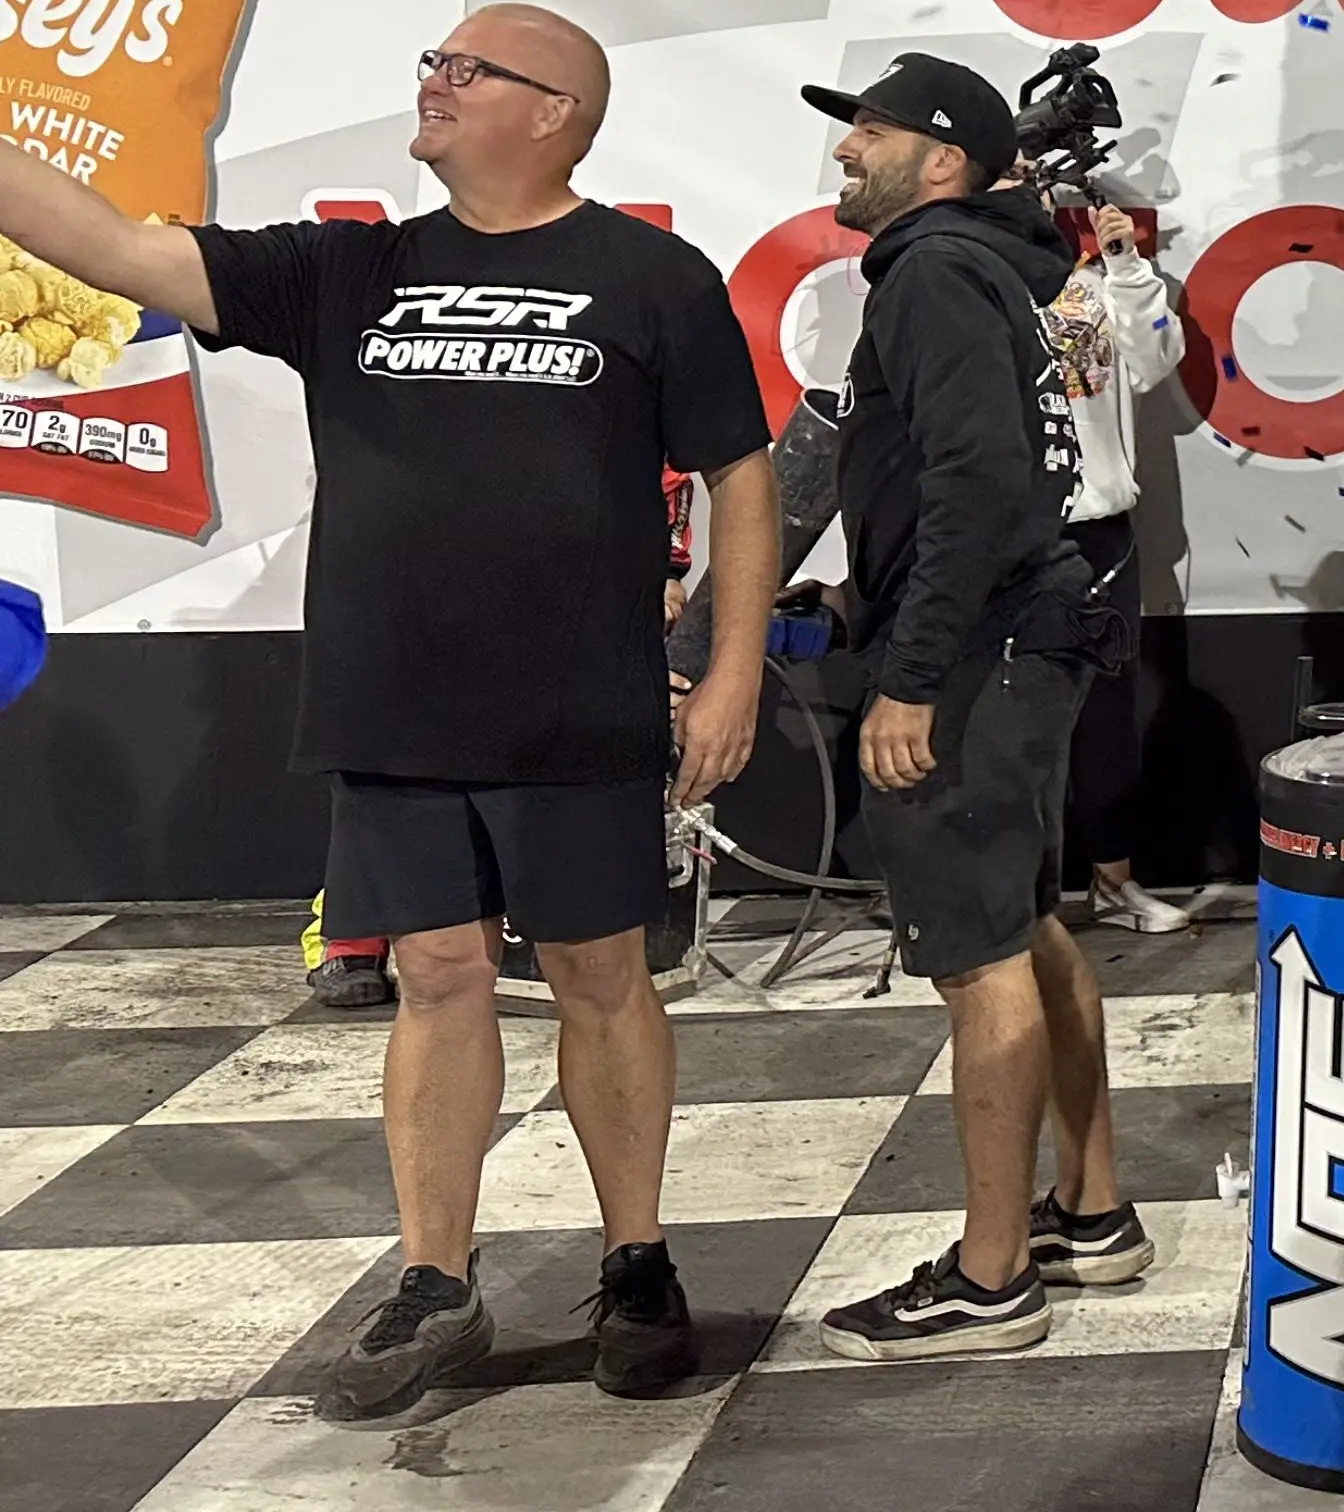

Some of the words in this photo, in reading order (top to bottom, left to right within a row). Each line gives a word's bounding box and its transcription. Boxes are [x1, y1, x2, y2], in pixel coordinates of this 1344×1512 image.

[20, 78, 91, 112] FLAVORED
[11, 101, 125, 161] WHITE
[378, 285, 593, 330] RSR
[364, 336, 487, 371] POWER
[487, 342, 586, 376] PLUS!
[85, 423, 122, 442] 390mg
